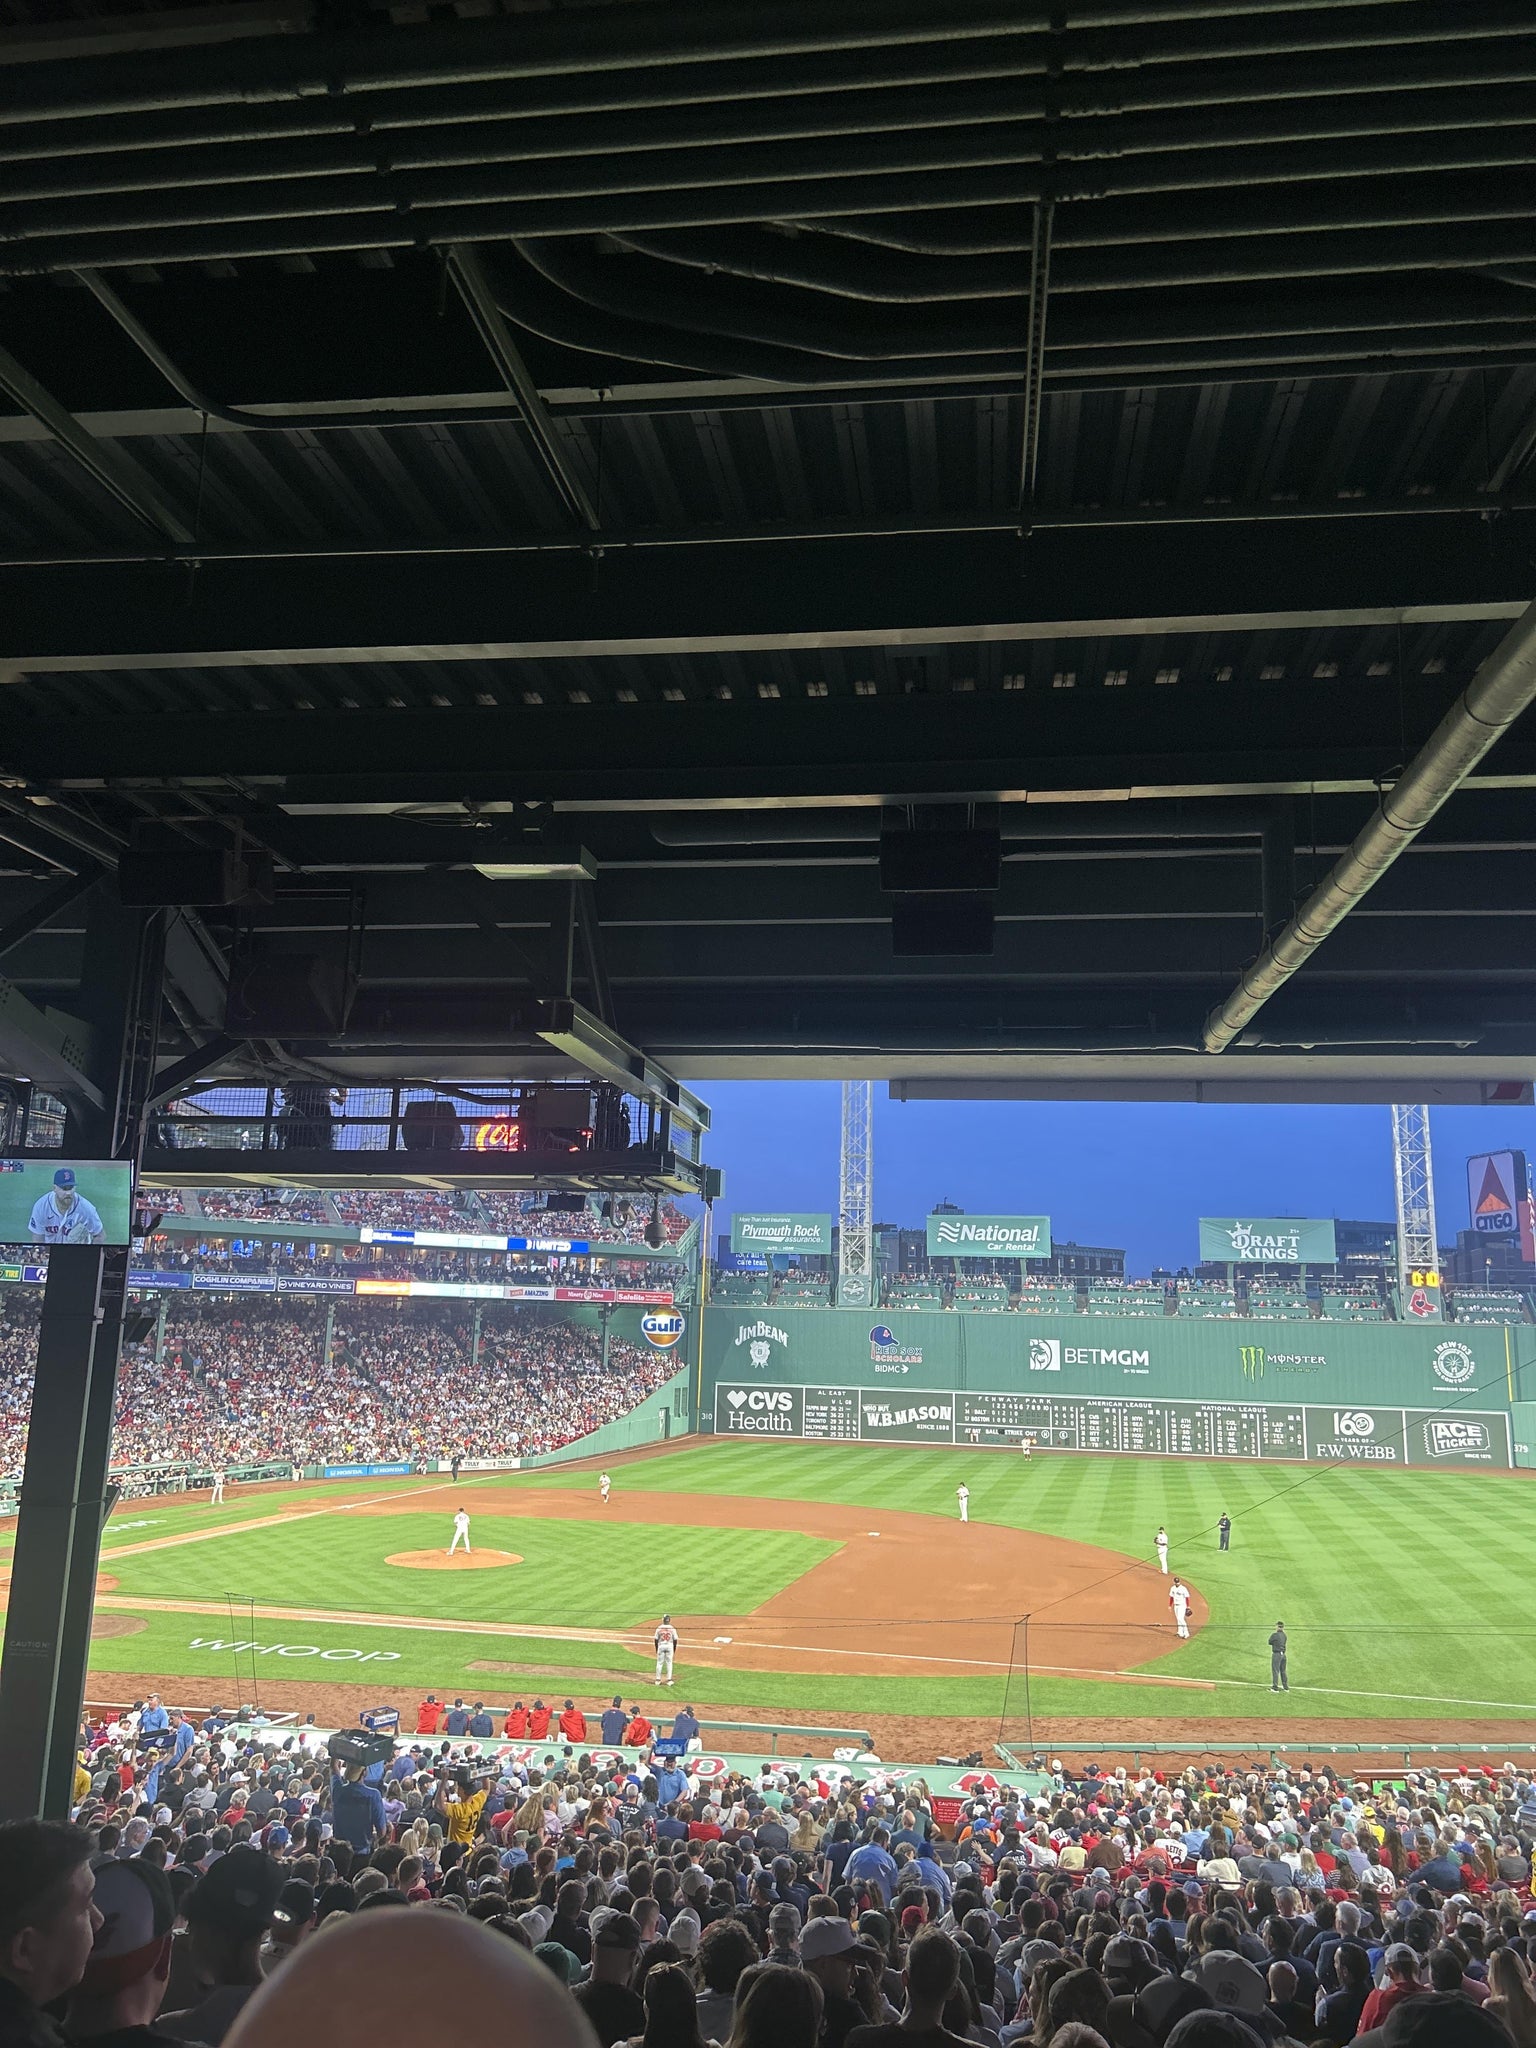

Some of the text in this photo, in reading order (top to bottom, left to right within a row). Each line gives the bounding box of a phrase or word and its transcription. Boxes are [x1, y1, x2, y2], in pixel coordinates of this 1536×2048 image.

[1476, 1213, 1512, 1230] CITGO
[742, 1225, 820, 1237] Plymouth Rock
[1232, 1234, 1299, 1249] DRAFT
[1240, 1248, 1298, 1259] KINGS
[230, 1277, 275, 1285] COMPANIES
[618, 1293, 644, 1301] Safelite
[644, 1318, 682, 1332] Gulf
[876, 1347, 897, 1355] RED
[1434, 1341, 1472, 1356] IBEW 103
[875, 1355, 922, 1363] SCHOLARS
[1064, 1348, 1149, 1366] BETMGM
[1267, 1354, 1326, 1365] MONSTER
[875, 1365, 900, 1373] BIDMC
[748, 1391, 793, 1411] CVS
[728, 1411, 792, 1431] Health
[1334, 1412, 1374, 1436] 160
[1437, 1423, 1482, 1438] ACE
[1438, 1438, 1482, 1449] TICKET
[1514, 1444, 1528, 1453] 379
[1316, 1444, 1396, 1459] F.W. WEBB
[660, 1633, 671, 1641] 36
[189, 1638, 401, 1662] WHOOP
[1166, 1845, 1182, 1855] BETTS
